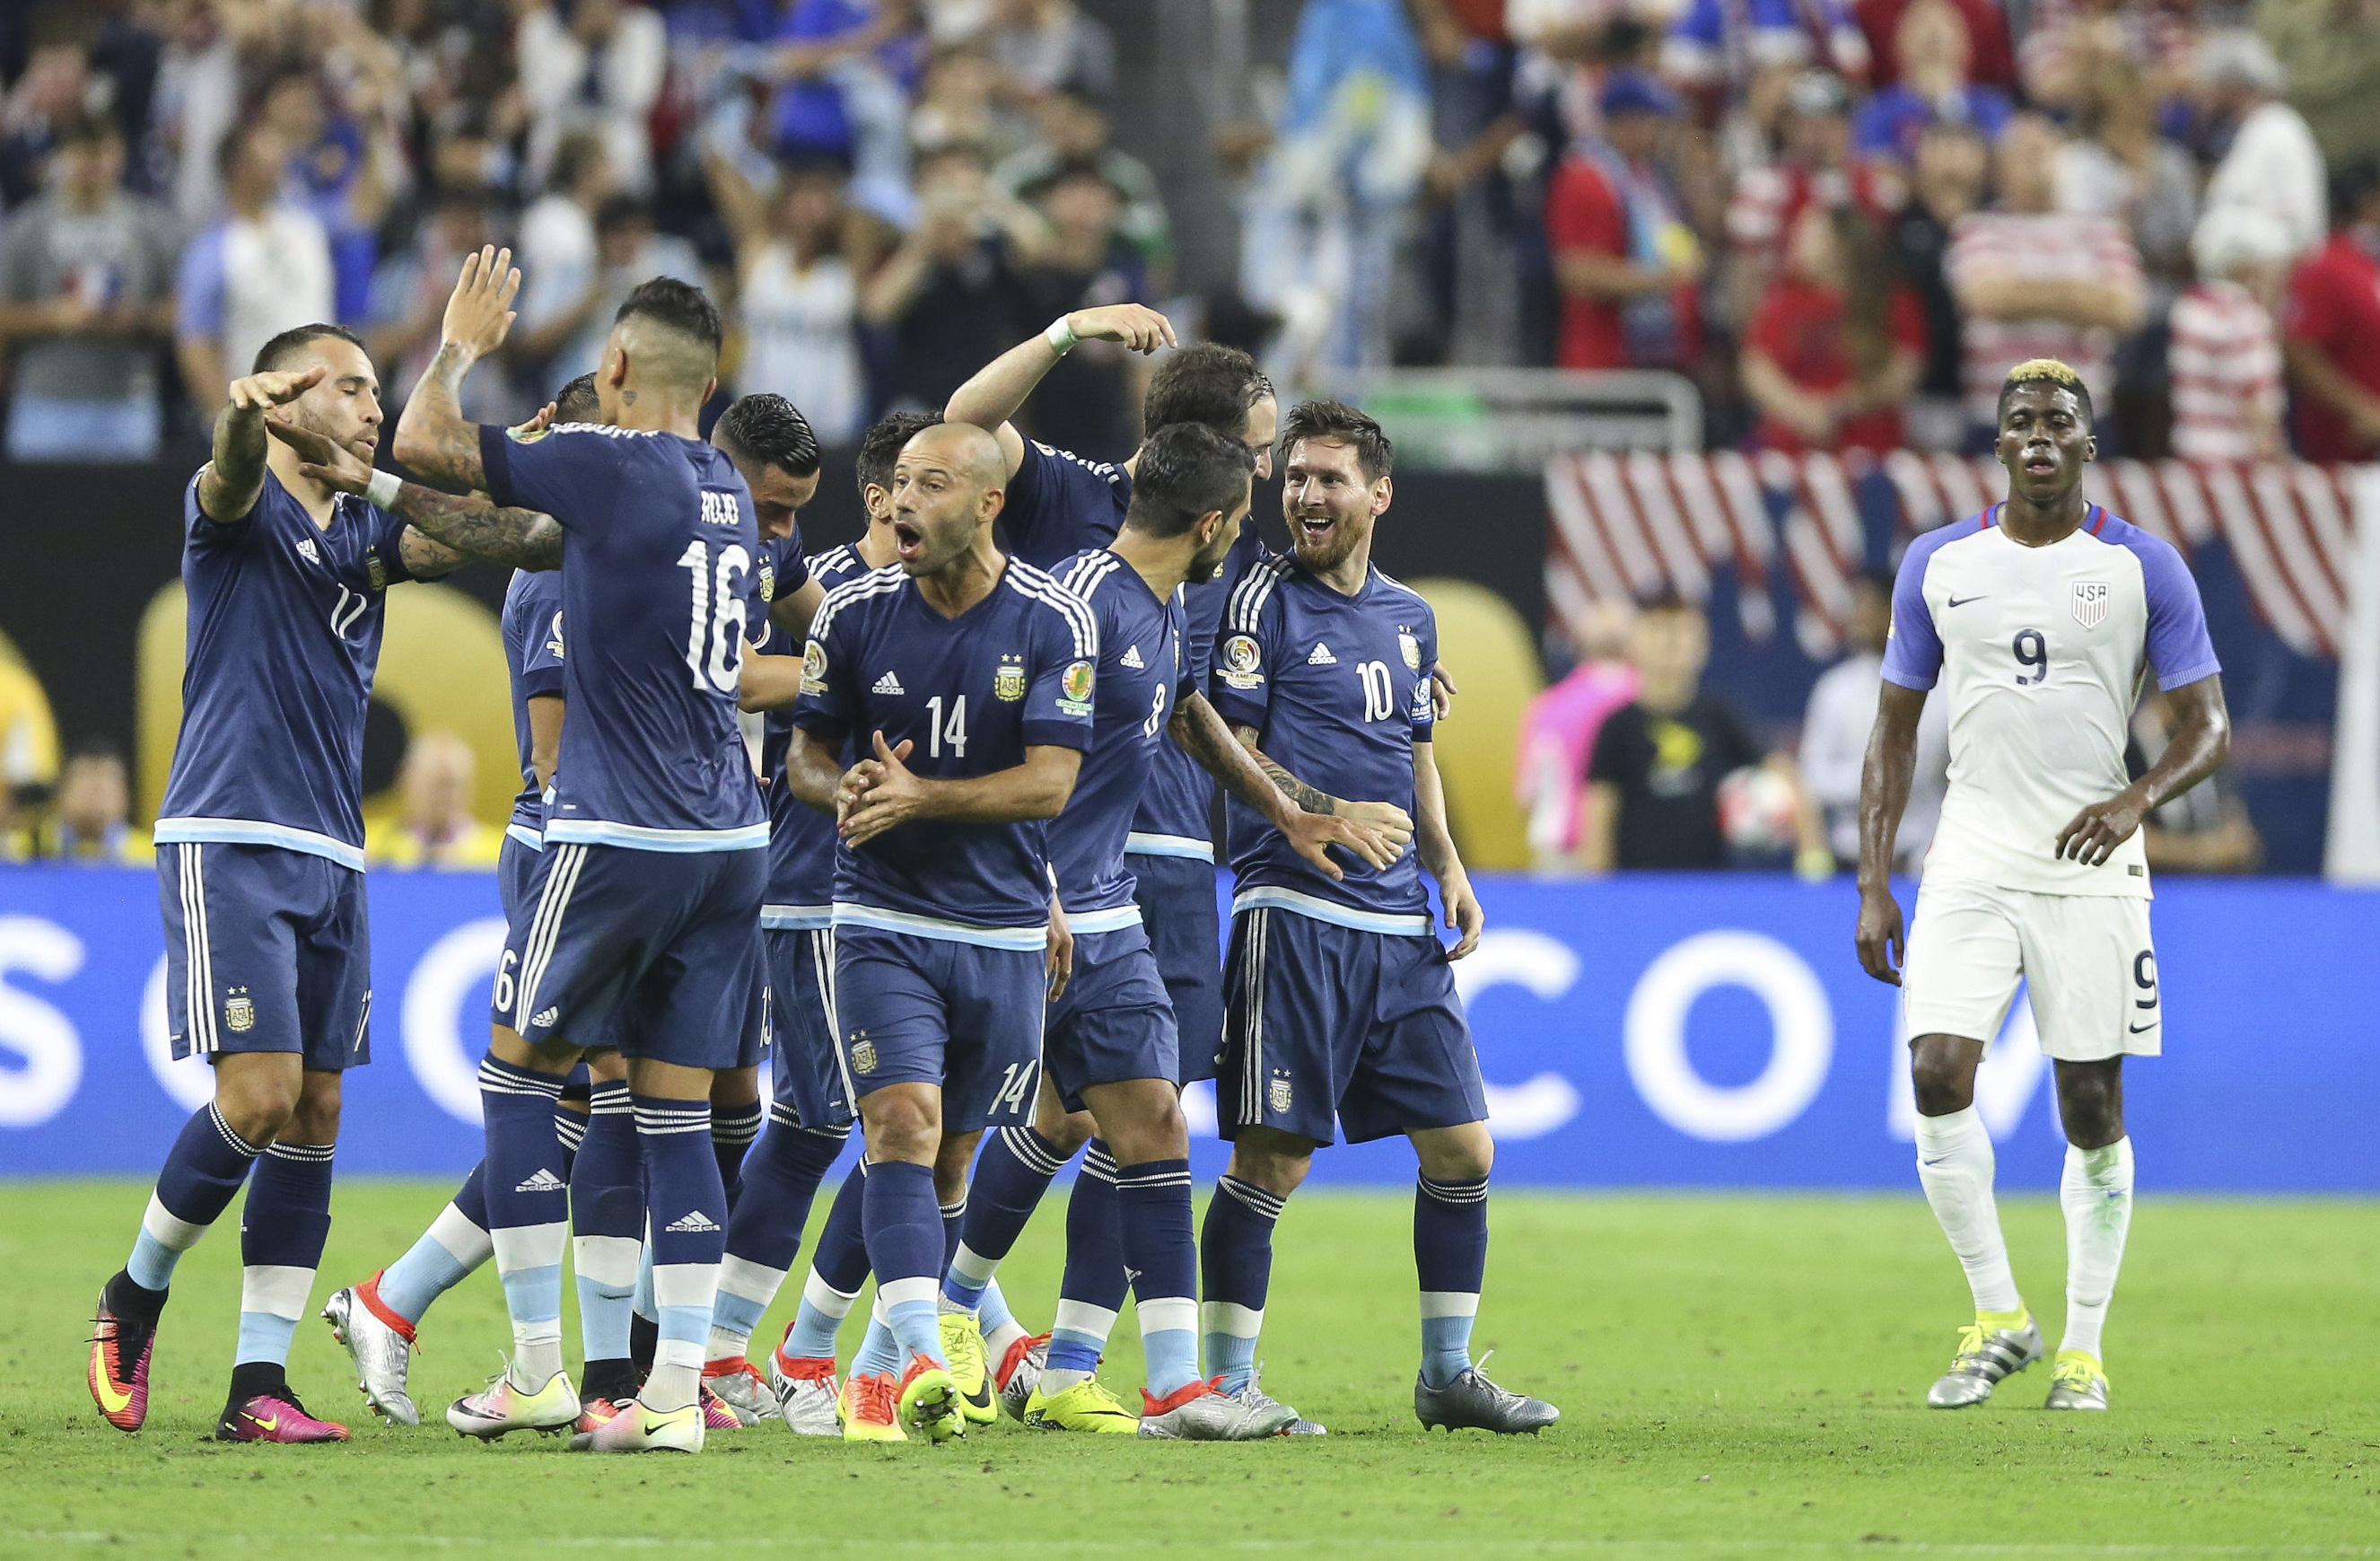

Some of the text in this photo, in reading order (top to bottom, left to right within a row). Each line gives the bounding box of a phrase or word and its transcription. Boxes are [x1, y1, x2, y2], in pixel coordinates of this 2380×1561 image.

[701, 491, 739, 525] ROJO
[677, 540, 750, 691] 16
[2076, 585, 2107, 602] USA
[2013, 628, 2047, 686] 9
[871, 685, 905, 696] adidas
[1143, 682, 1166, 739] 8
[1355, 660, 1394, 723] 10
[925, 694, 967, 758] 14
[2134, 950, 2157, 1009] 9
[987, 1058, 1037, 1116] 14
[514, 1182, 566, 1193] adidas
[665, 1223, 721, 1232] adidas
